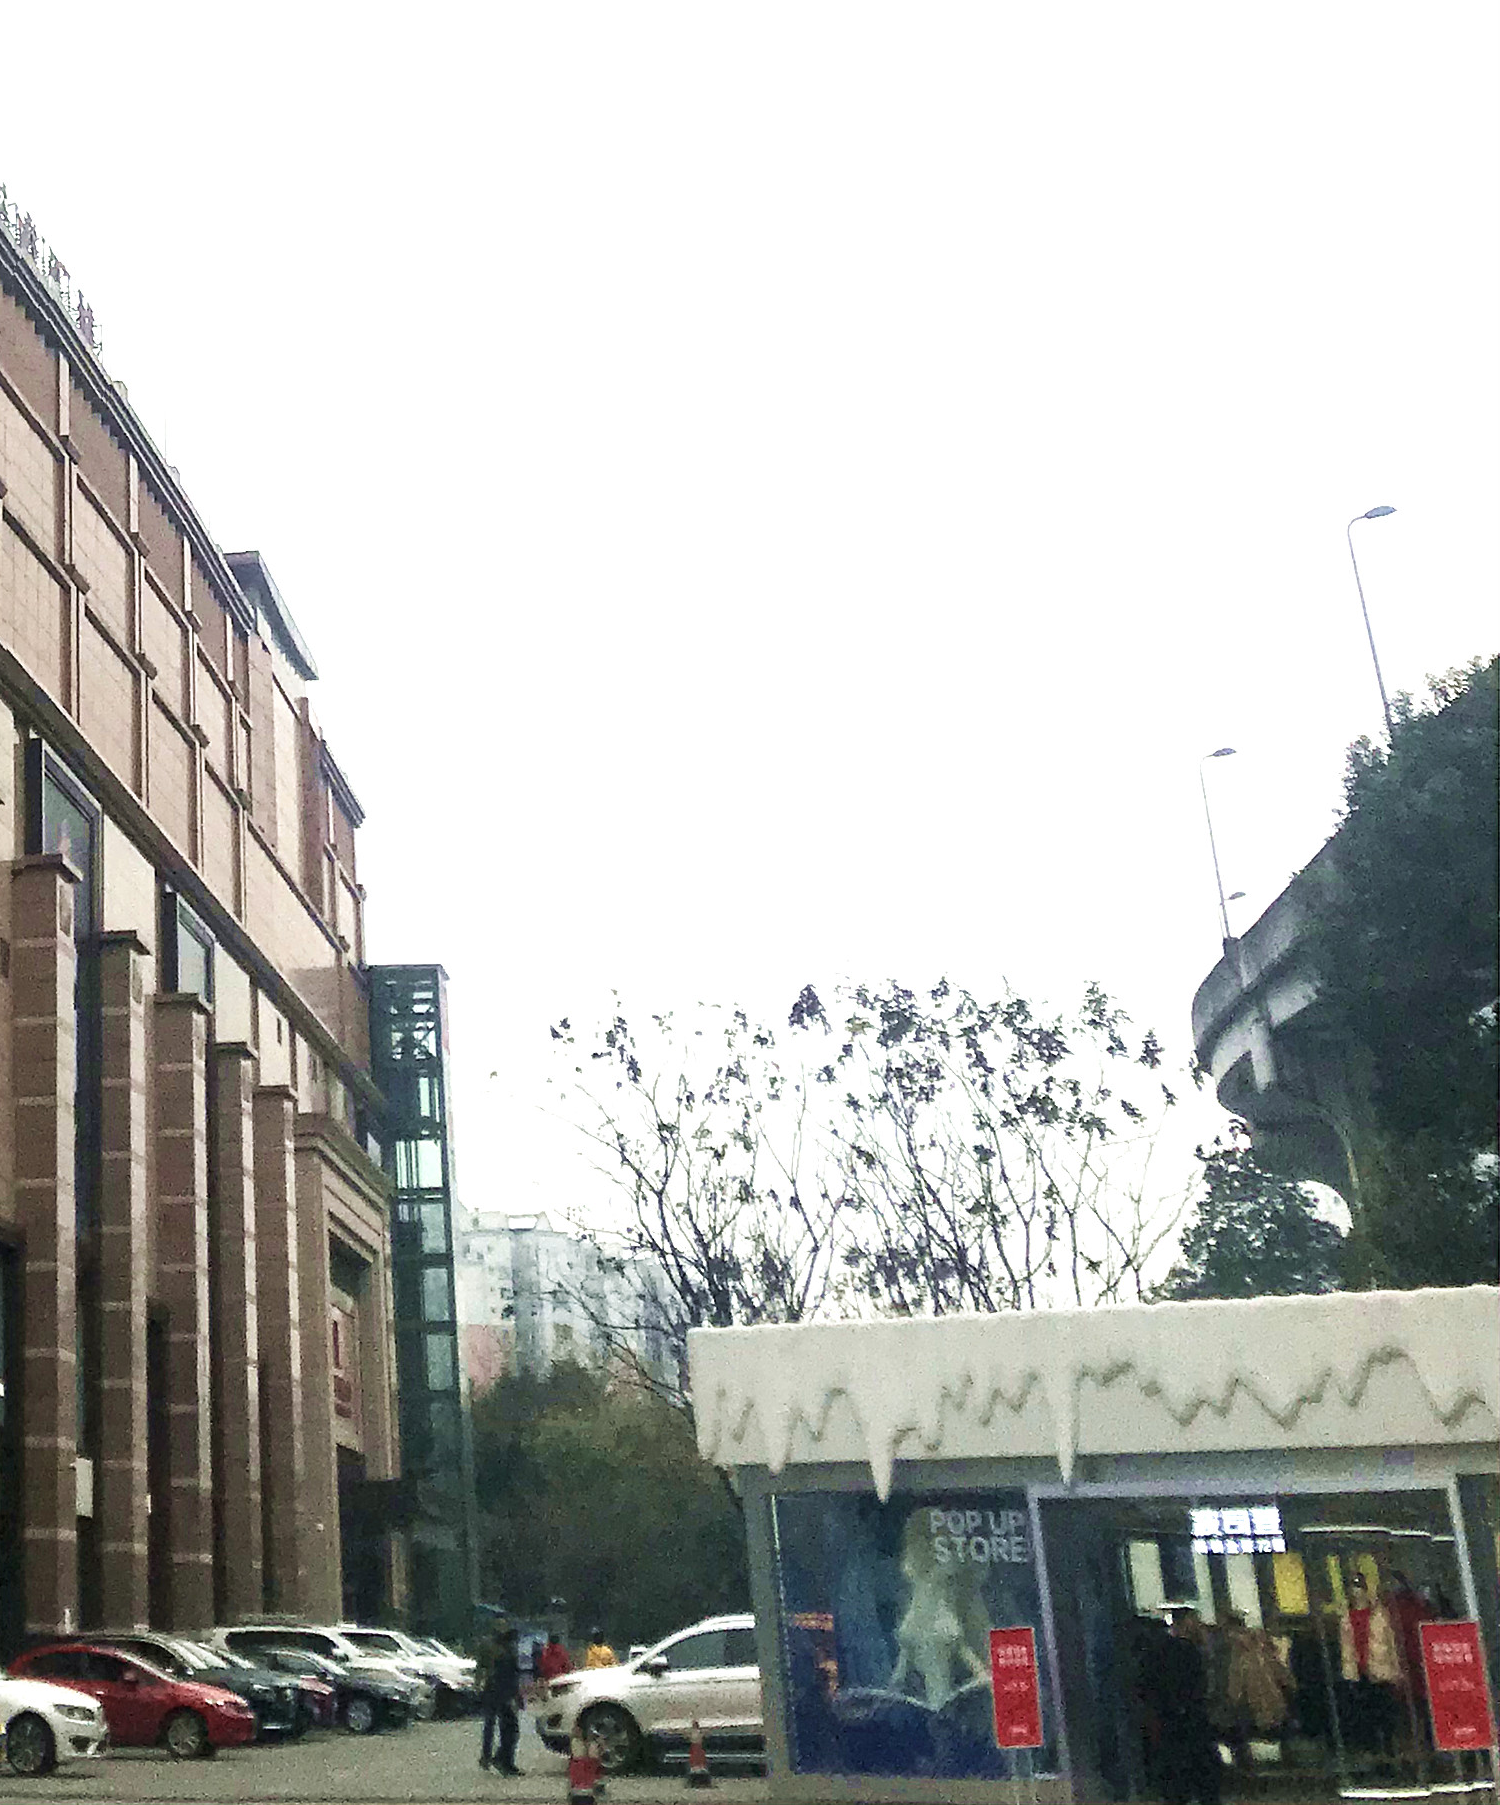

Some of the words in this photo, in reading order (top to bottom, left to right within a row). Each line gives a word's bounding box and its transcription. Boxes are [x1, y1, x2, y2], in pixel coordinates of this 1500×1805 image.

[929, 1510, 983, 1535] POP
[987, 1510, 1027, 1535] UP
[934, 1536, 1028, 1564] STORE
